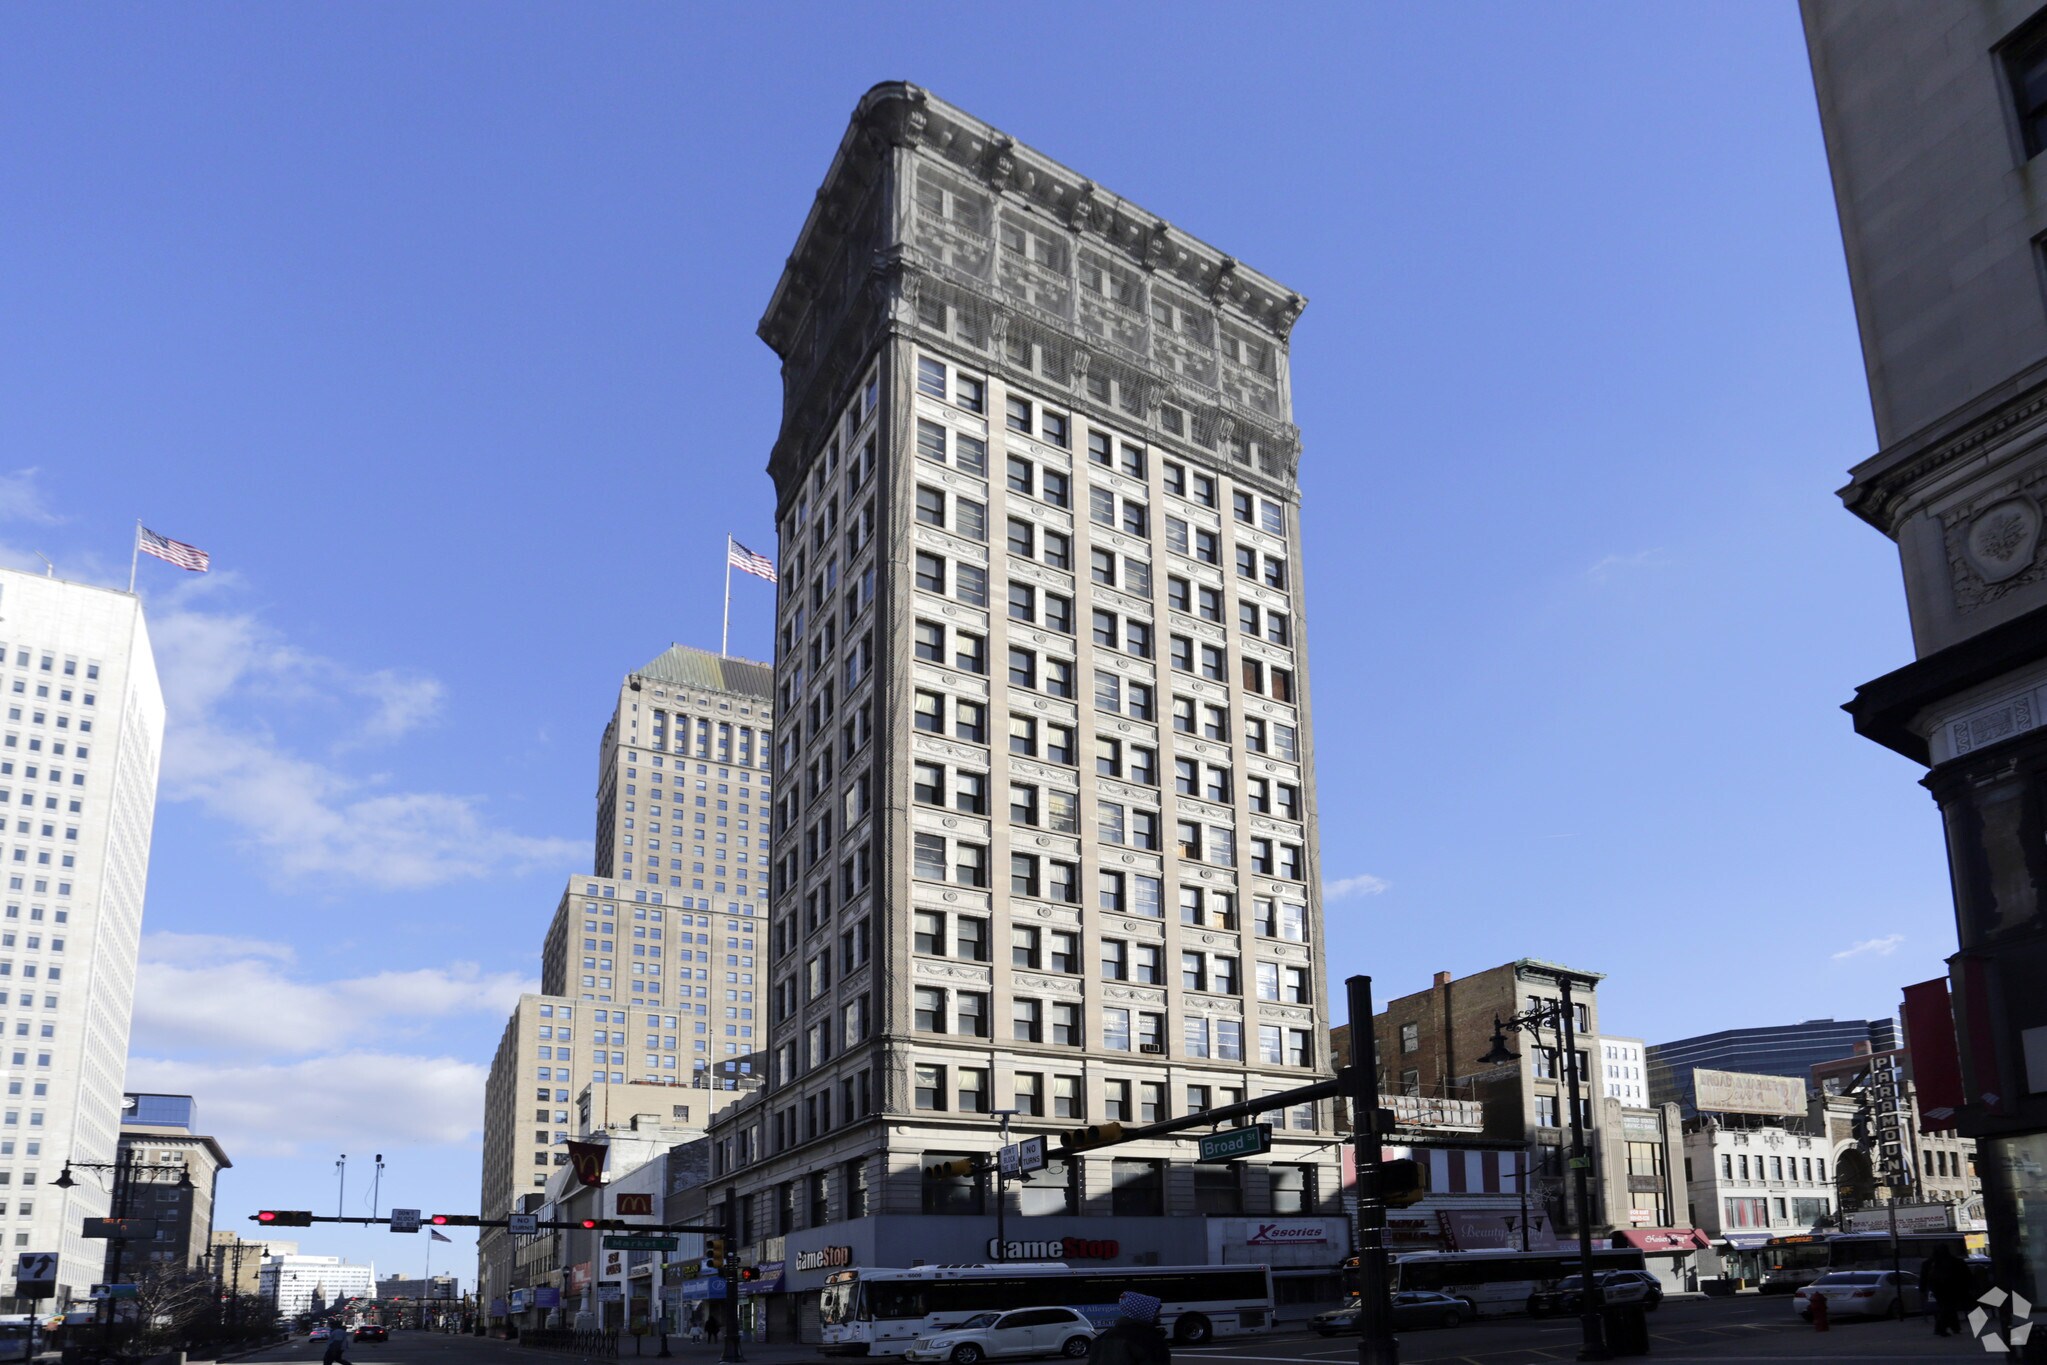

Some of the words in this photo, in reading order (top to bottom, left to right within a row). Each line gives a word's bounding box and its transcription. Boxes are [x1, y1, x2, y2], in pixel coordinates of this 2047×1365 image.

[1876, 1057, 1901, 1185] PARAMOUNT
[1003, 1147, 1015, 1156] DON'T
[1026, 1144, 1036, 1154] NO
[1204, 1136, 1244, 1155] Broad
[1247, 1133, 1256, 1141] St
[1023, 1155, 1040, 1165] TURNS
[1461, 1223, 1505, 1242] Beauty
[795, 1247, 849, 1271] GameStop
[988, 1238, 1119, 1260] GameStop
